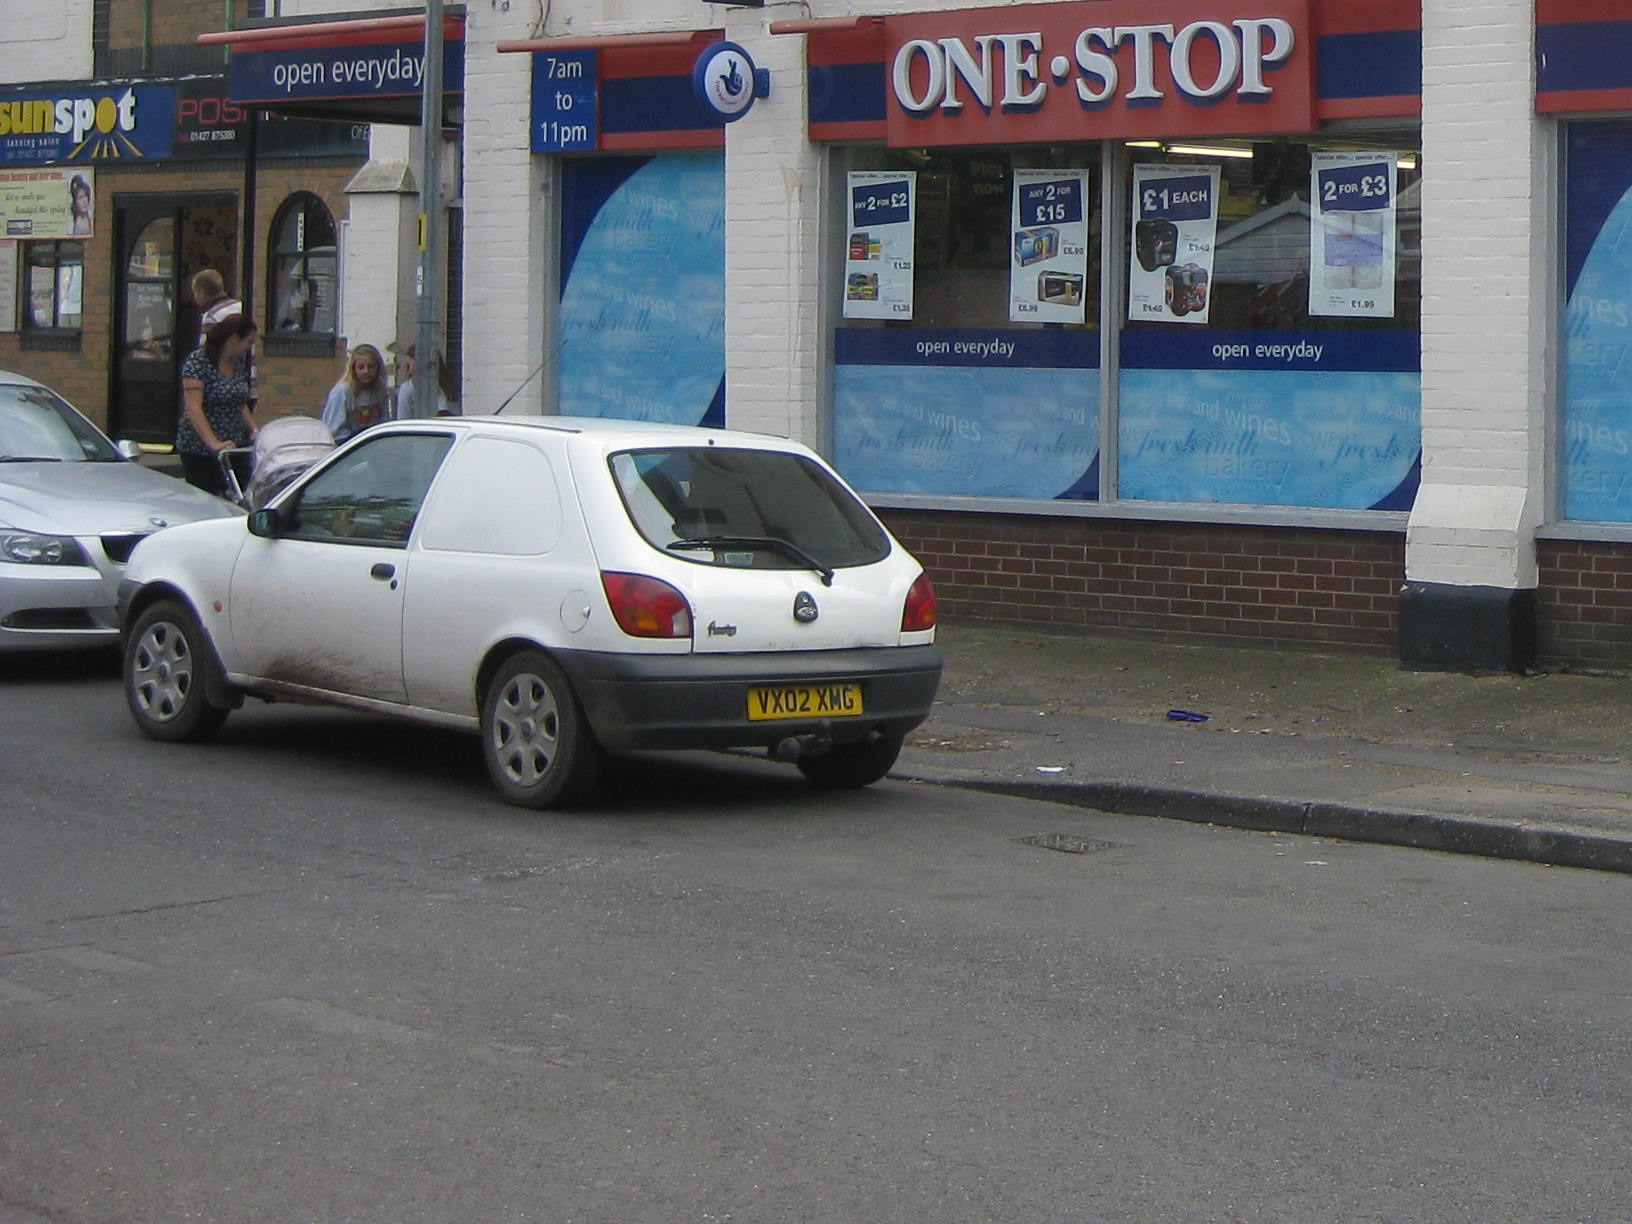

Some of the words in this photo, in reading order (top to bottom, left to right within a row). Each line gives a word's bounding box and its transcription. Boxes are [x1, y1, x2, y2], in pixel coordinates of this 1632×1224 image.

[274, 61, 325, 92] open
[332, 48, 426, 89] everyday
[547, 58, 583, 79] 7am
[555, 89, 573, 111] to
[0, 87, 137, 144] sunspot
[540, 122, 588, 147] 11pm
[1029, 190, 1044, 199] ANY
[1045, 185, 1056, 201] 2
[1056, 186, 1071, 196] FOR
[1324, 181, 1338, 201] 2
[1339, 183, 1359, 195] FOR
[1360, 174, 1387, 197] £3
[867, 196, 877, 211] 2
[877, 197, 890, 207] FOR
[891, 192, 908, 208] £2
[1143, 188, 1169, 211] £1
[1172, 189, 1208, 204] EACH
[1035, 204, 1066, 222] £15
[916, 339, 950, 357] open
[954, 337, 1016, 358] everyday
[1212, 342, 1249, 361] open
[1255, 339, 1324, 362] everyday
[758, 689, 811, 714] VX02
[816, 686, 855, 712] XMG
